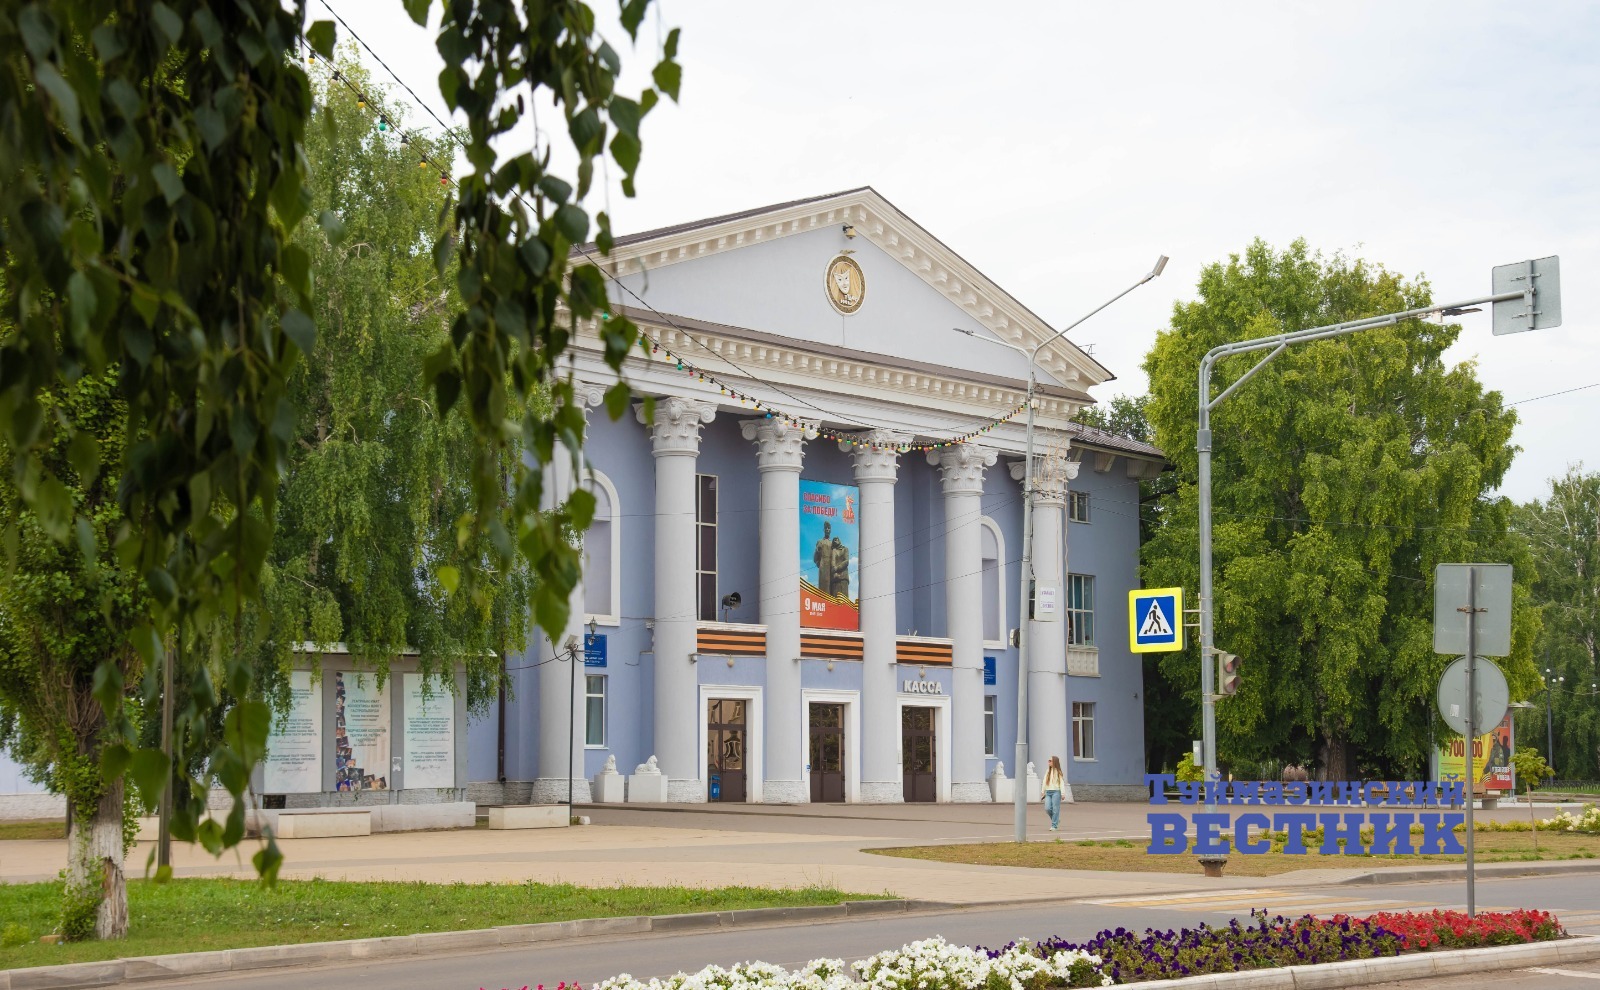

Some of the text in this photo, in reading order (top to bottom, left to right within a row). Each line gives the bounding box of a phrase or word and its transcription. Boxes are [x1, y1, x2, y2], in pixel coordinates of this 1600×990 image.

[803, 493, 831, 503] СПАСИБО
[803, 504, 811, 513] ЗА
[812, 506, 838, 517] ПОБЕДУ!
[804, 597, 826, 612] 9 МАЯ
[903, 680, 943, 694] КАССА
